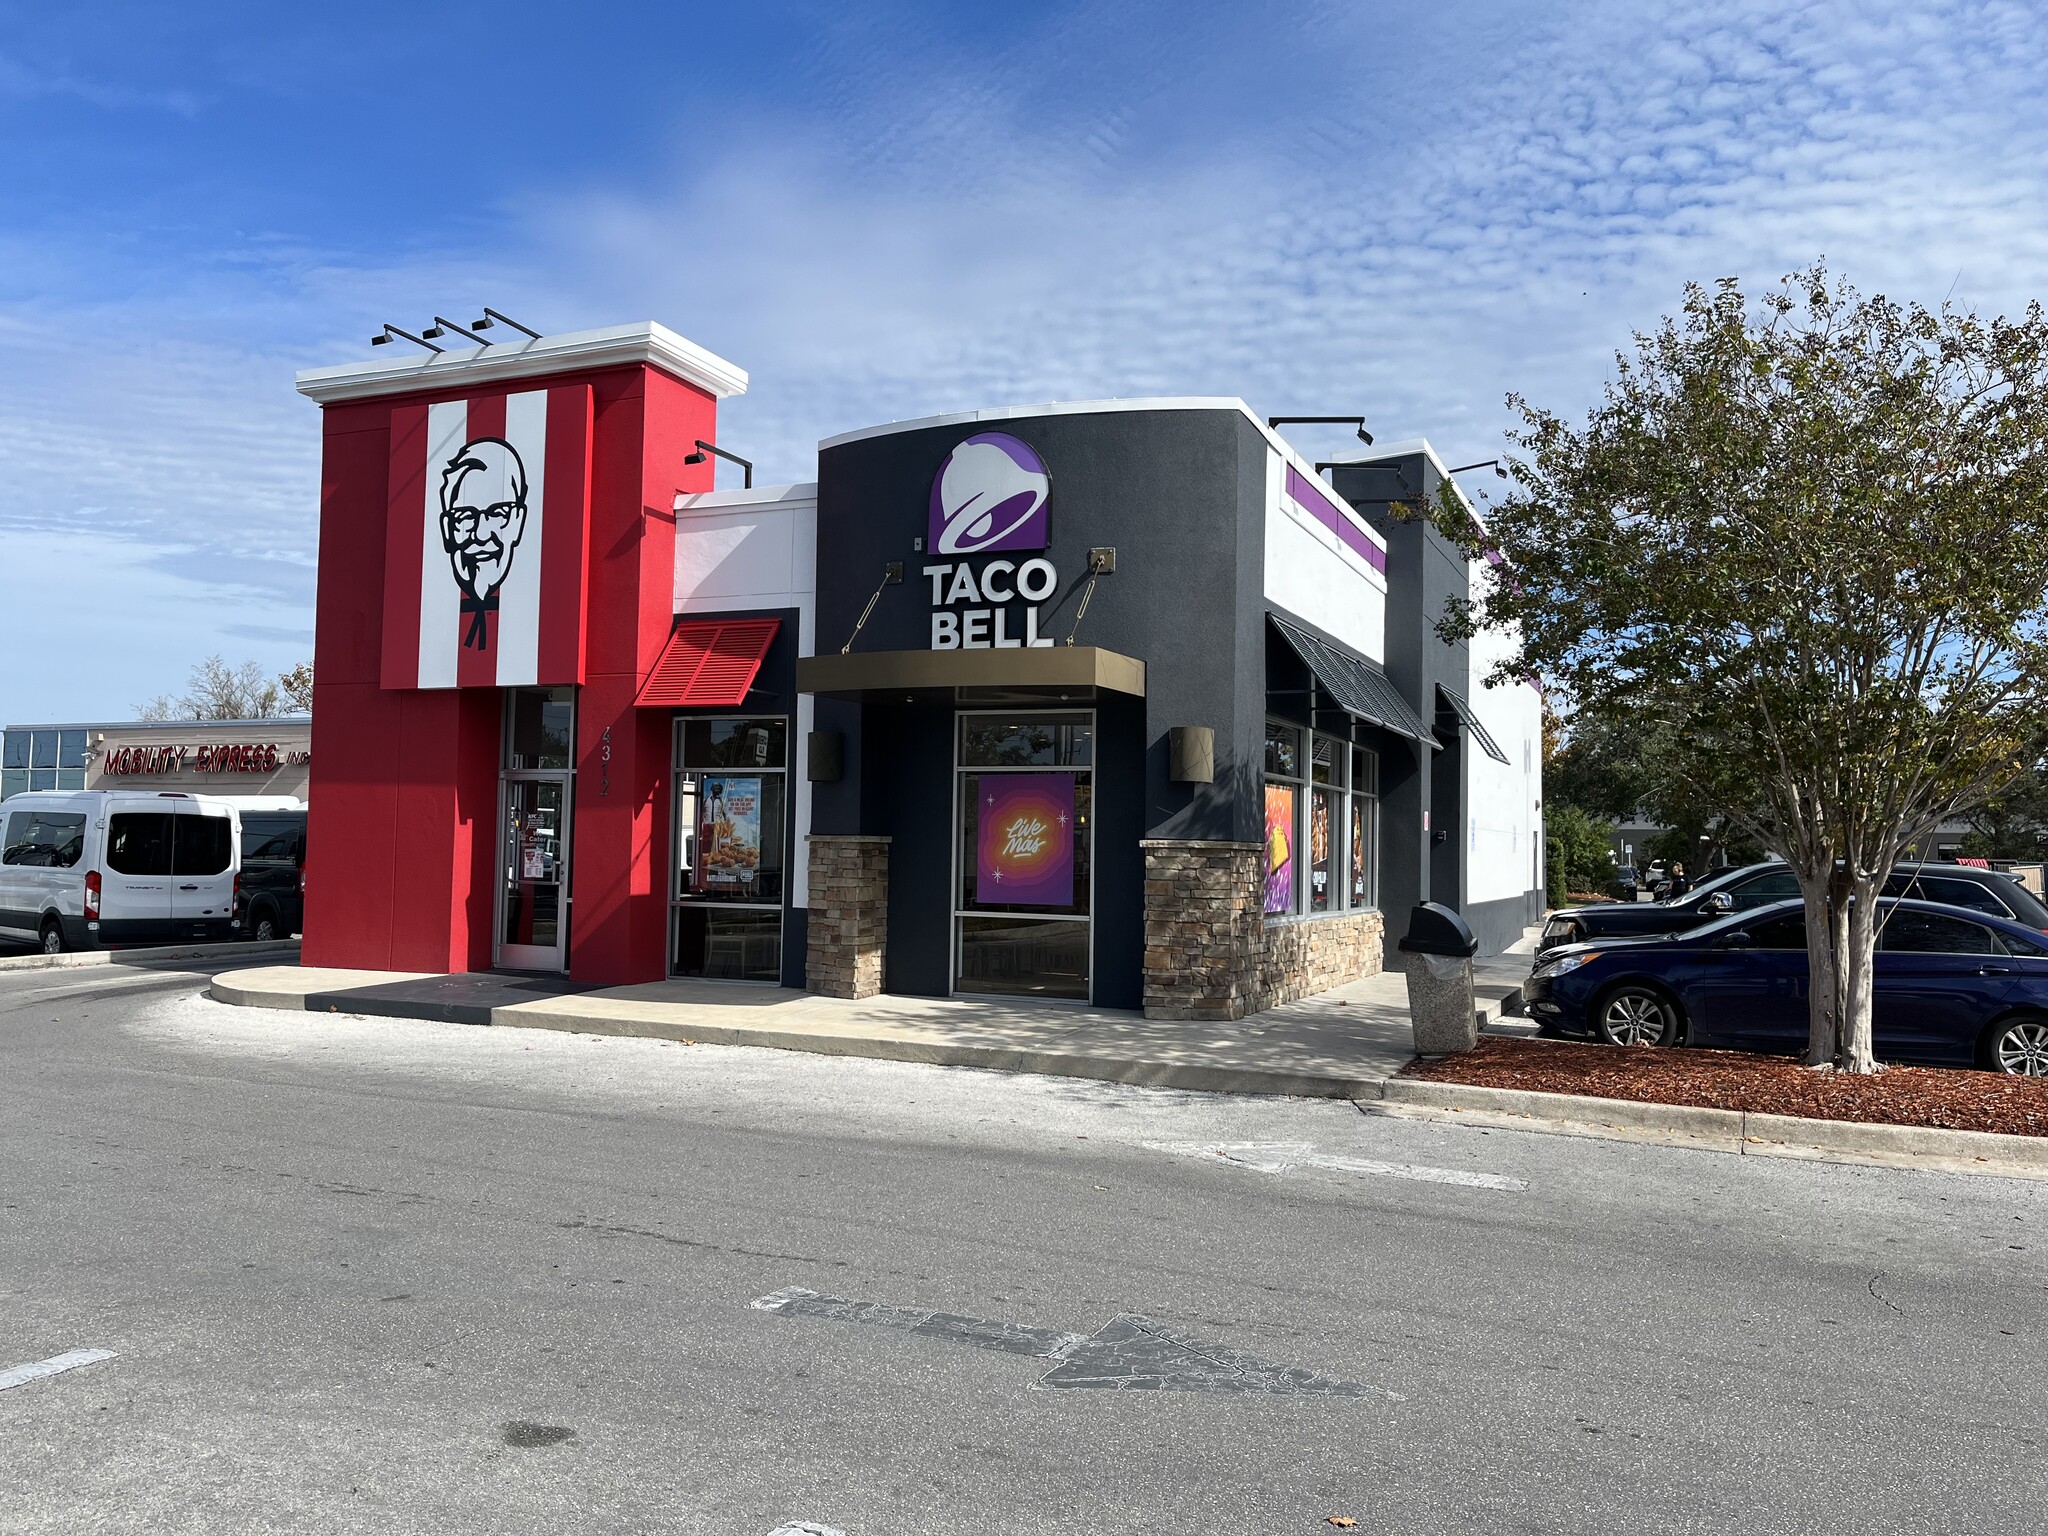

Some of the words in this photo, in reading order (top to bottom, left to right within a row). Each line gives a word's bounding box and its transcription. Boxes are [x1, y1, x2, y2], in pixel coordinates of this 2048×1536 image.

[923, 558, 1058, 606] TACO
[931, 606, 1054, 650] BELL
[103, 746, 188, 775] MOBILITY
[193, 744, 279, 773] EXPRESS
[601, 727, 611, 796] 4312
[1003, 835, 1046, 855] Más
[1007, 818, 1046, 839] Live
